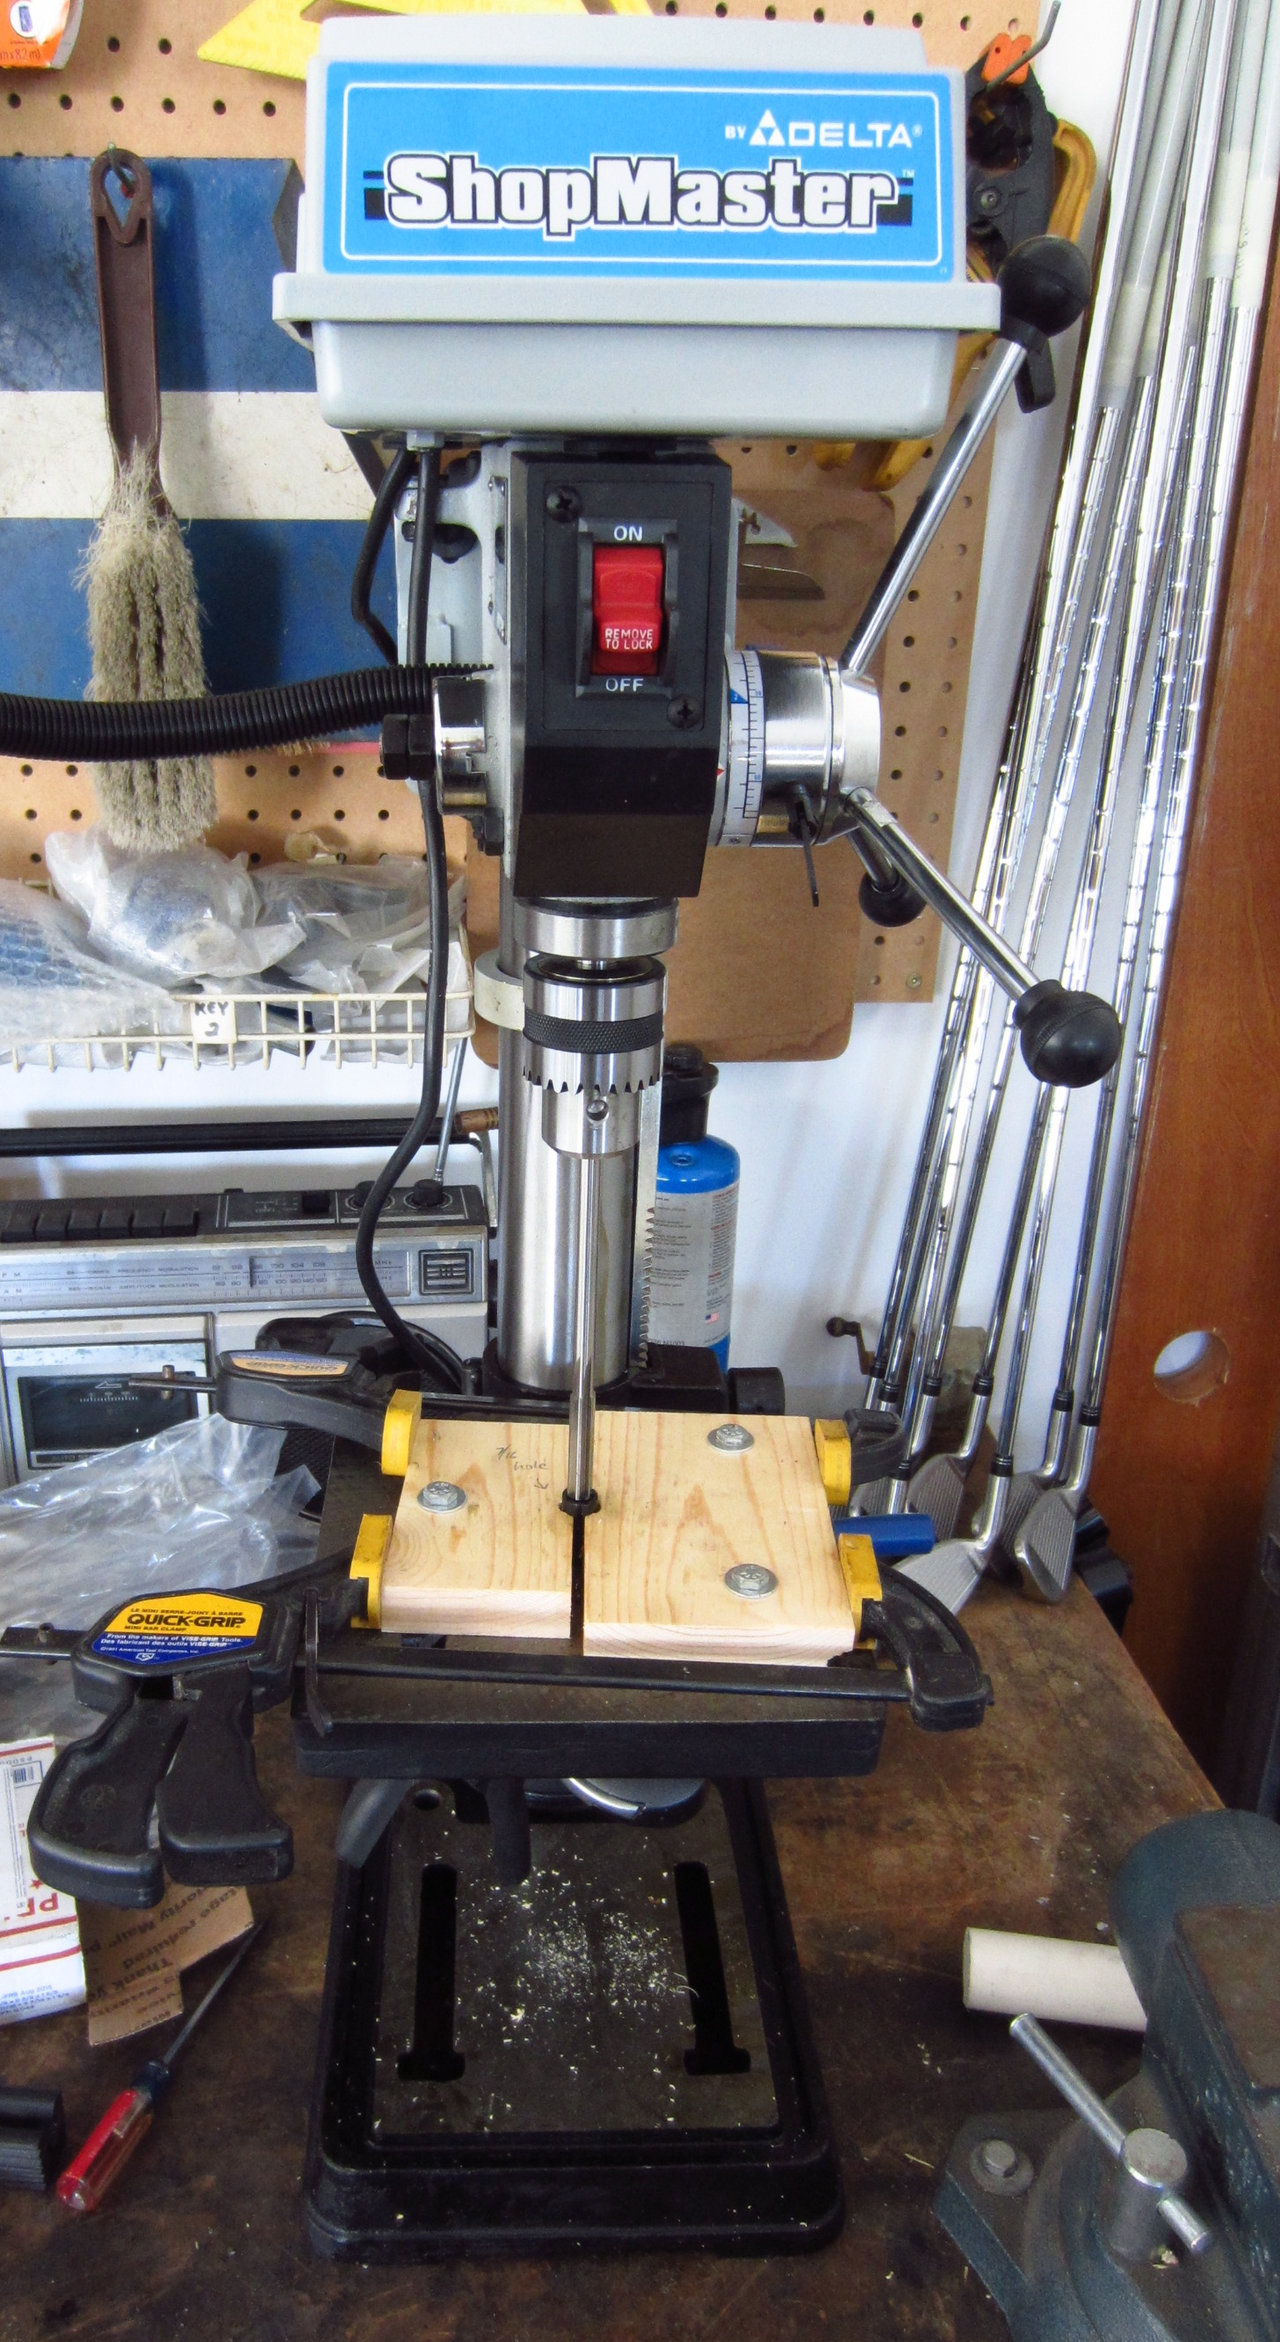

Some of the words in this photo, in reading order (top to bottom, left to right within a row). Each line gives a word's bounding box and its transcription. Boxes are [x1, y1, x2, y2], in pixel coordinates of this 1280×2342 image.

[724, 124, 747, 140] BY
[788, 121, 913, 148] DELTA
[385, 152, 899, 240] ShopMaster
[613, 525, 643, 541] ON
[605, 628, 653, 640] REMOVE
[605, 639, 619, 649] TO
[624, 639, 653, 650] LOCK
[605, 678, 644, 692] OFF
[194, 1001, 228, 1016] KEY
[127, 1613, 246, 1629] QUICK-GRIP
